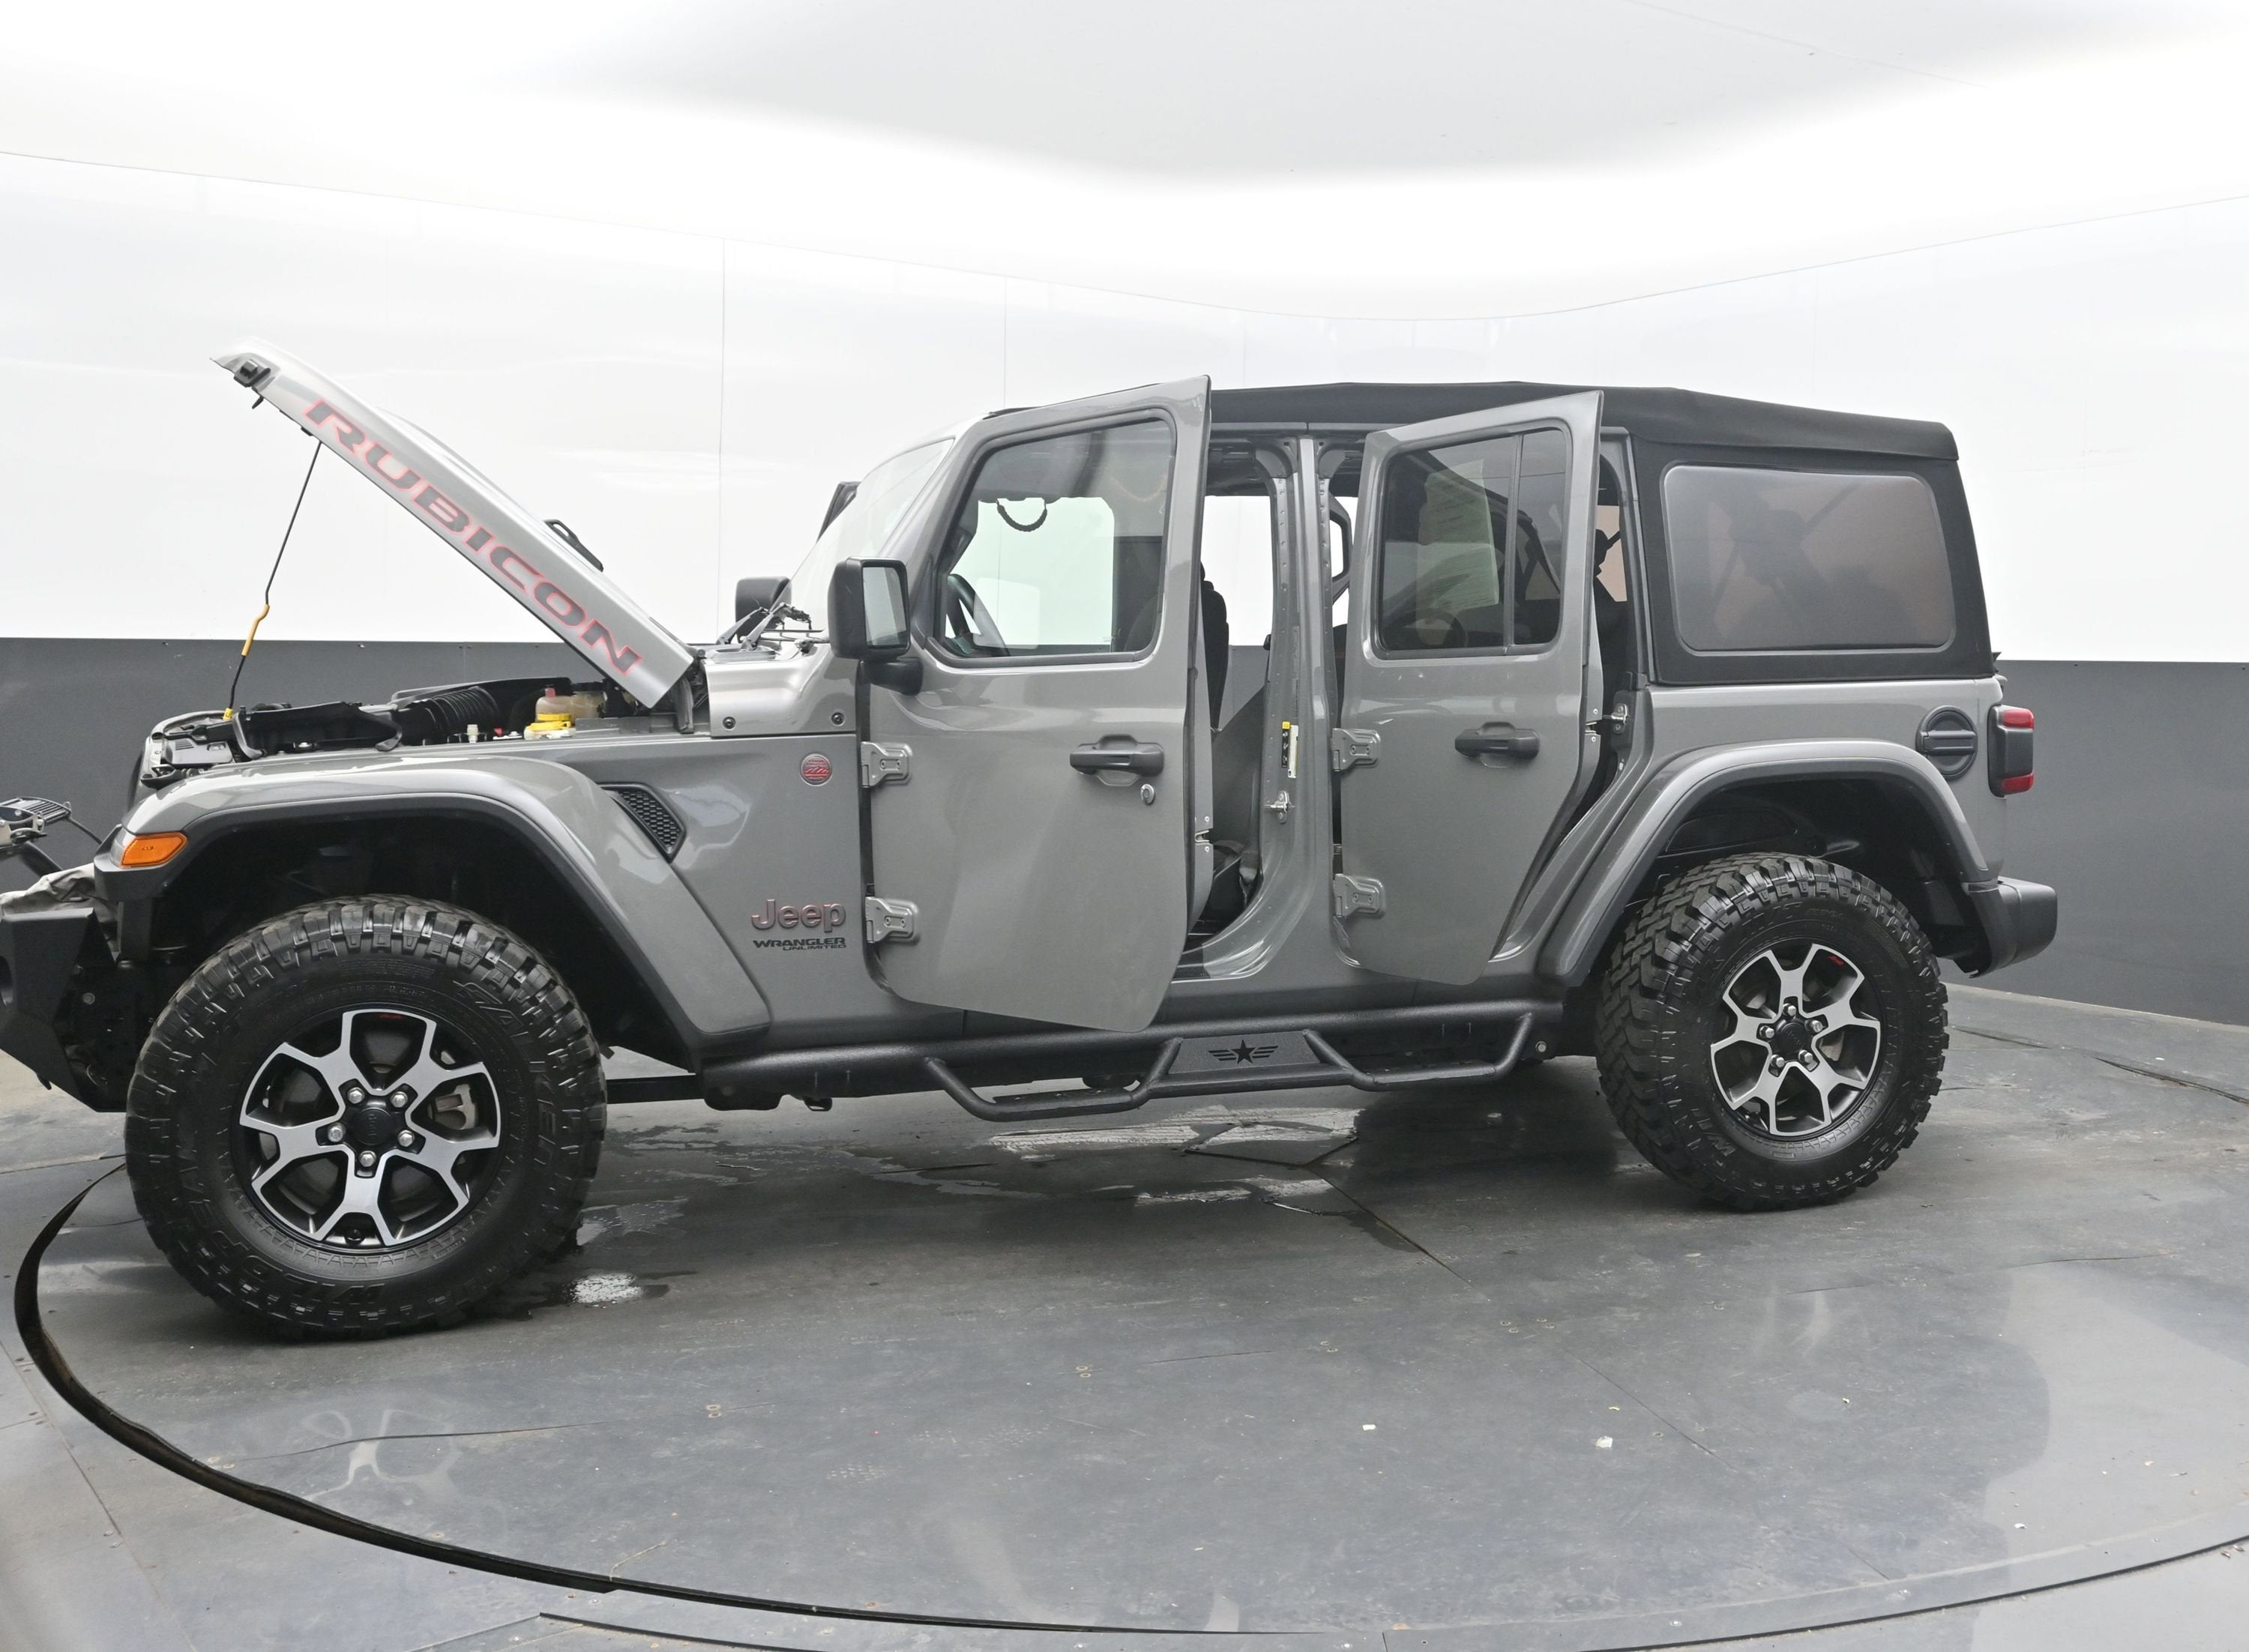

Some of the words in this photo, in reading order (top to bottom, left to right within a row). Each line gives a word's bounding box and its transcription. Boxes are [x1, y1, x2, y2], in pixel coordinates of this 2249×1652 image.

[304, 398, 643, 675] RUBICON
[751, 899, 846, 932] Jeep
[753, 937, 846, 948] WRANGLER
